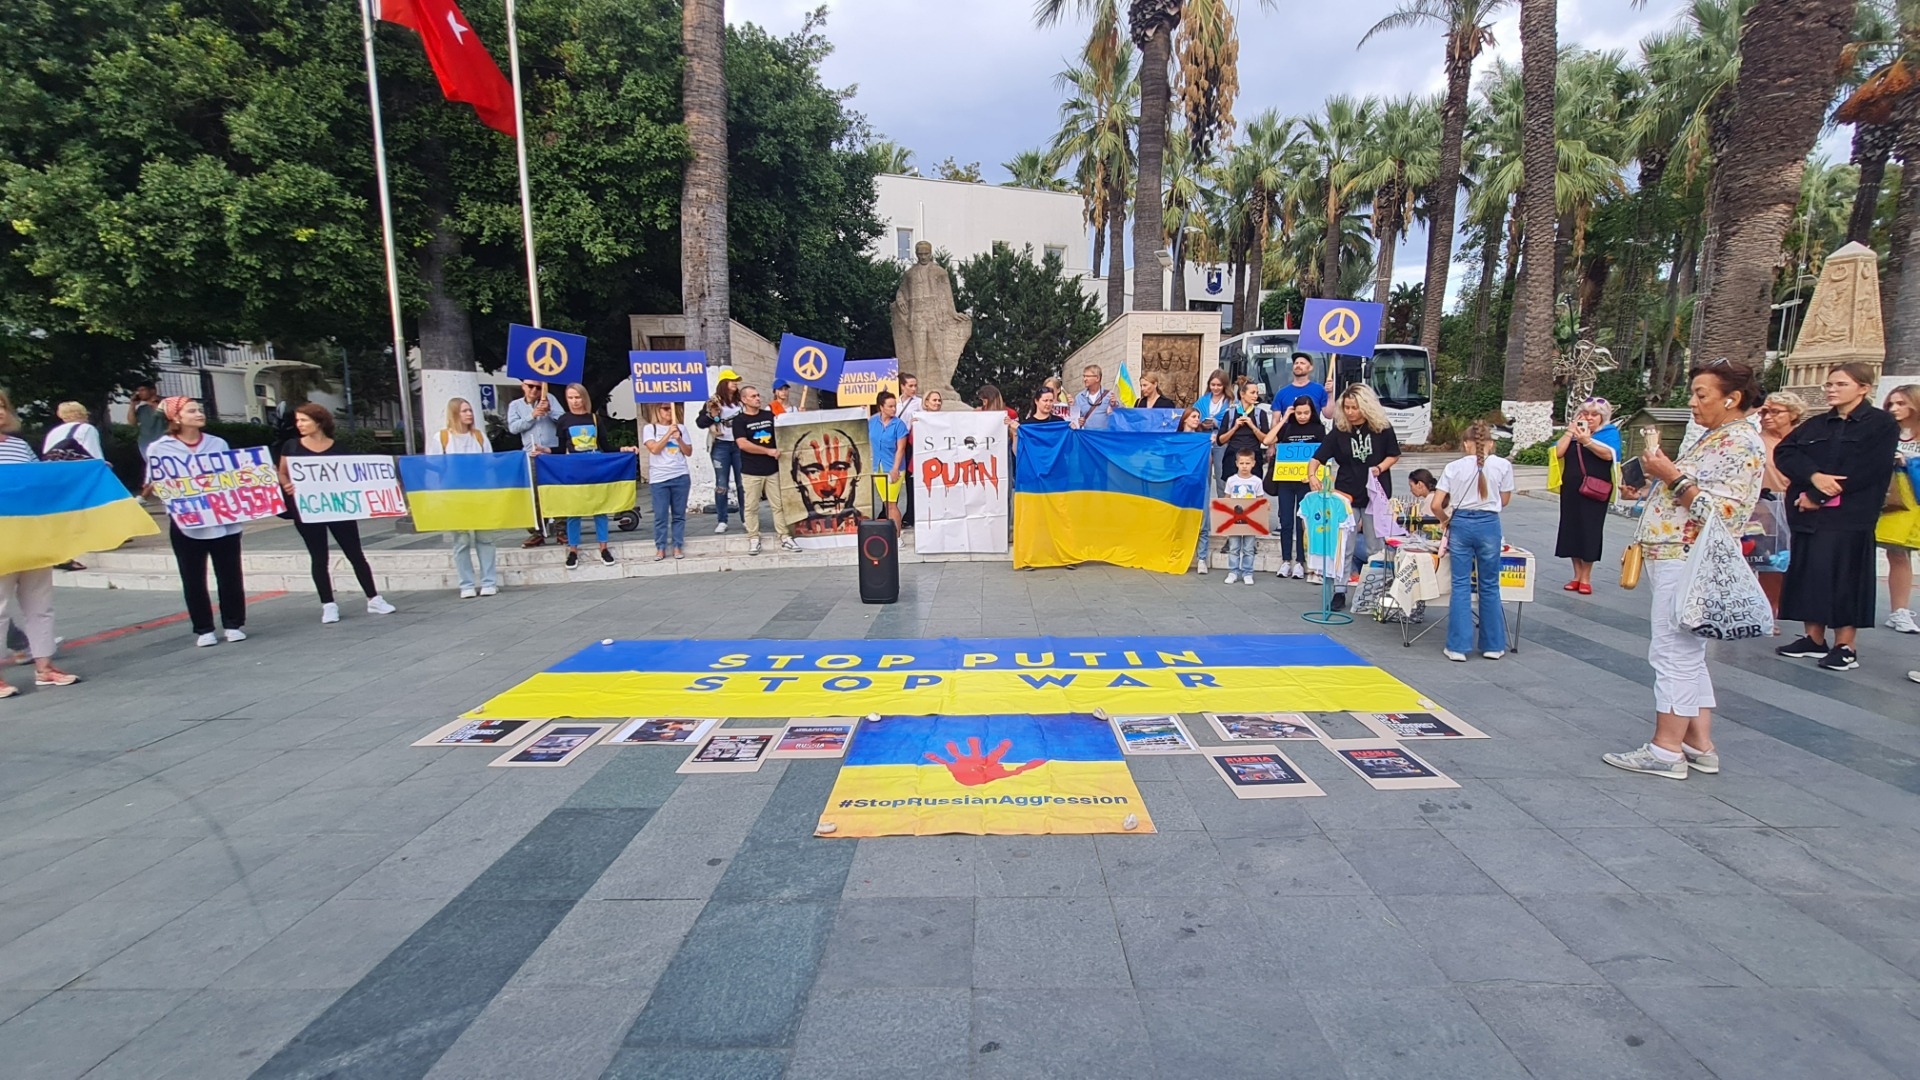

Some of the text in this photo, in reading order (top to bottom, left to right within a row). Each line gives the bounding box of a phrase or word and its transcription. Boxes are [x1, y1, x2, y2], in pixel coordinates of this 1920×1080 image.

[633, 362, 703, 377] ÇOCUKLAR
[635, 378, 692, 393] ÖLMESİN
[149, 446, 264, 481] BOYCOTT
[1276, 466, 1323, 477] GENOCE
[292, 462, 396, 483] STAY UNITED
[922, 455, 998, 498] PUTIN
[298, 485, 404, 515] AGAINST EVIL!
[709, 650, 1203, 669] STOP PUTIN
[684, 673, 1222, 692] STOP WAR
[1224, 756, 1275, 764] RUSSIA
[1349, 750, 1399, 758] RUSSIA
[838, 794, 1128, 808] #StopRussianAggression
